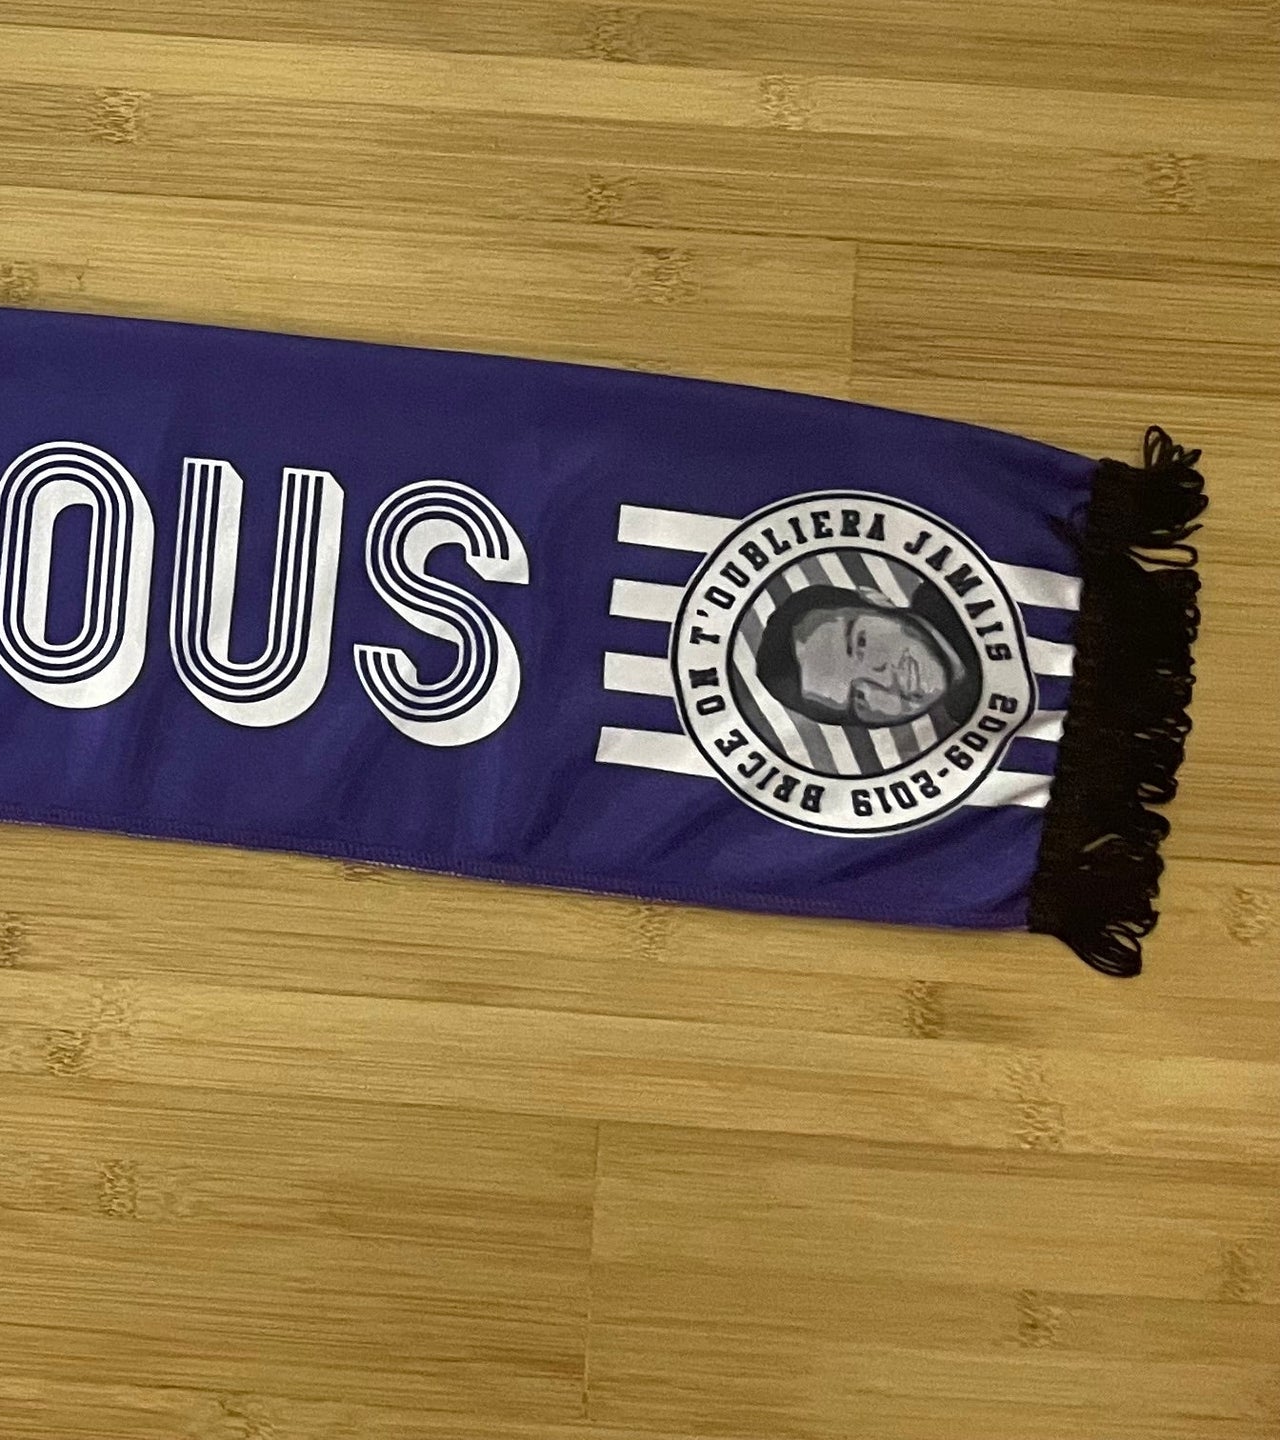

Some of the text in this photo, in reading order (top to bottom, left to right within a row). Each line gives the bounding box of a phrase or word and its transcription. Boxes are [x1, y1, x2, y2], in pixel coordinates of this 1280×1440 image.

[689, 509, 1018, 817] BRICE ON T'OUBLIERA JAMAIS 2009-2019
